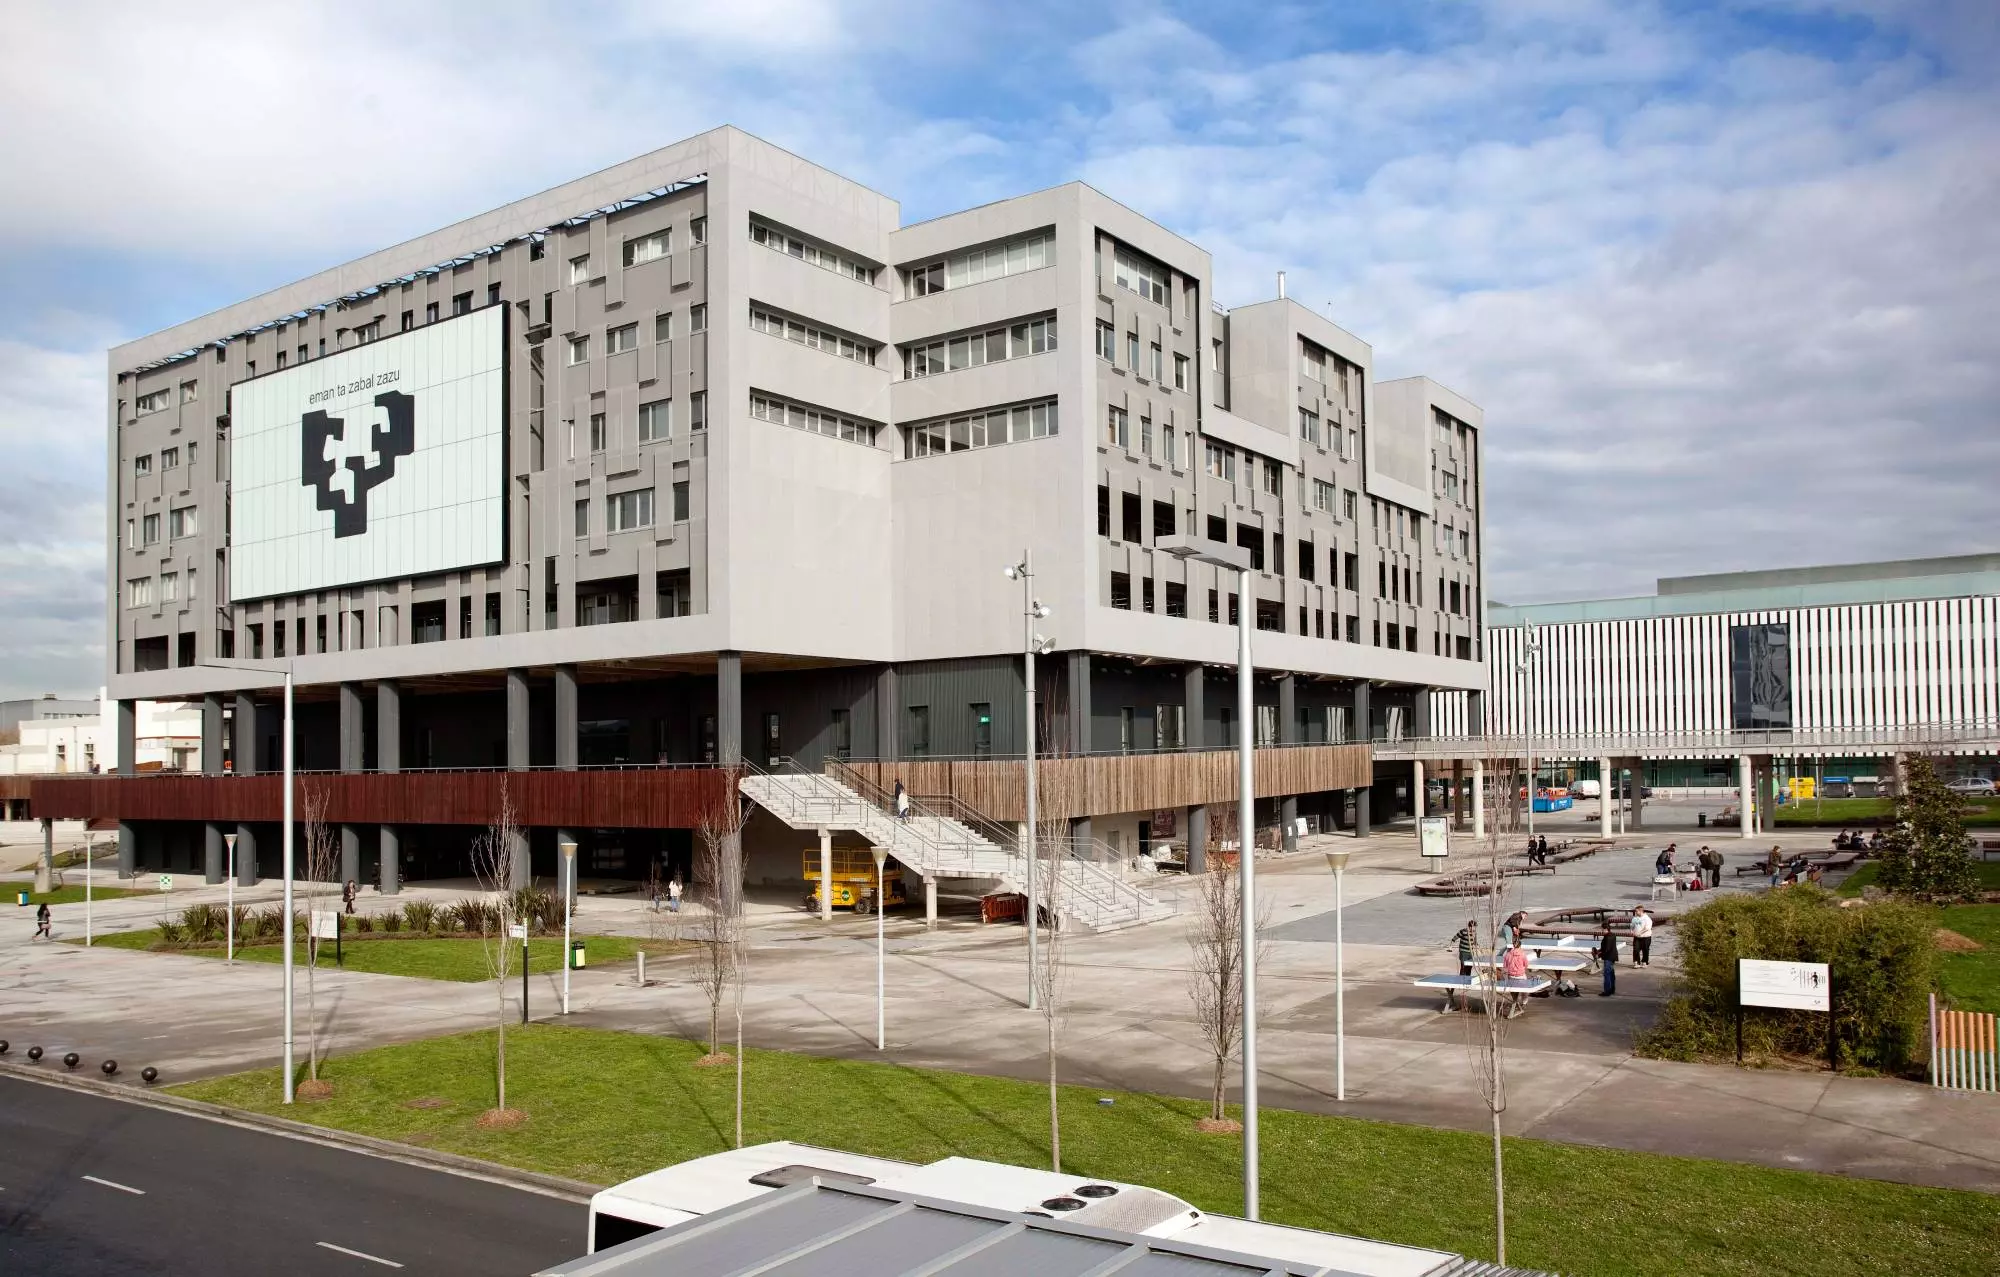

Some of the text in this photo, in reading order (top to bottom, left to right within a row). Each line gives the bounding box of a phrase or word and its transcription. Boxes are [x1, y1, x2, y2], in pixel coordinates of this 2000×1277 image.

[309, 369, 400, 404] eman ta zabal zazu
